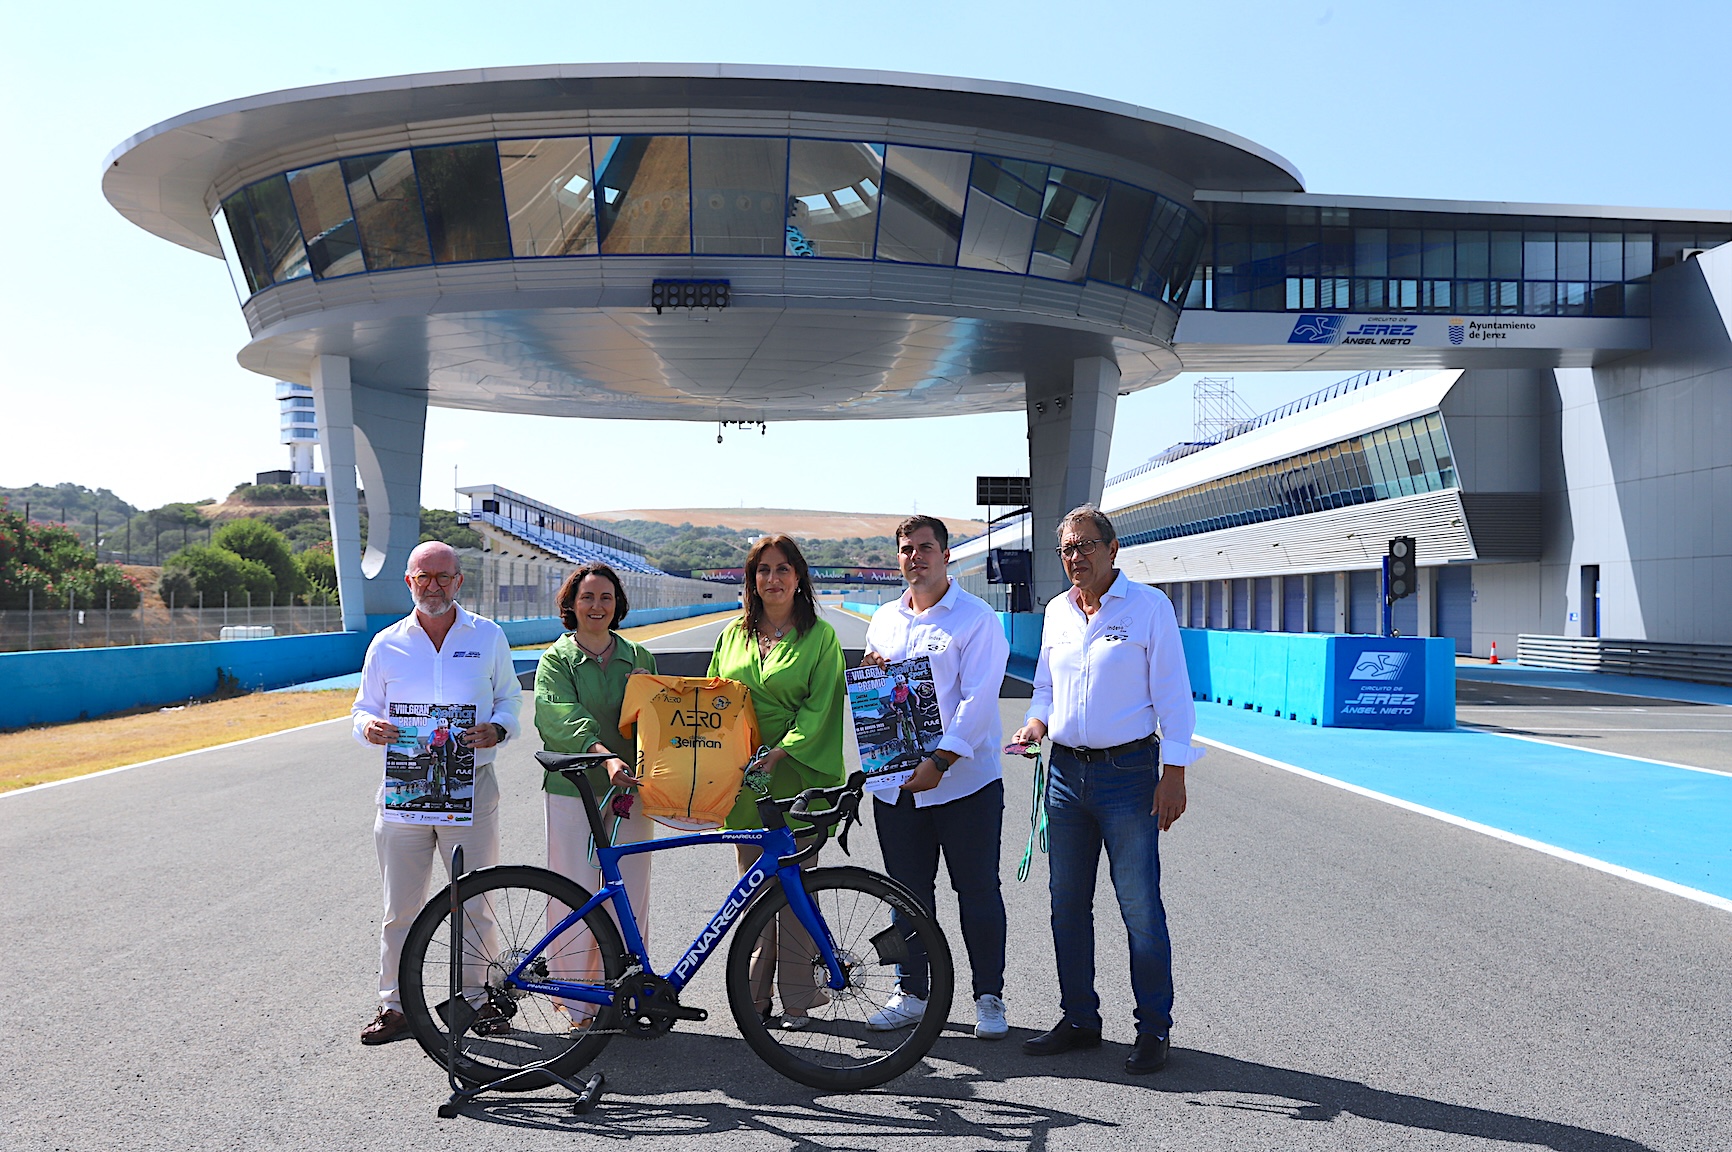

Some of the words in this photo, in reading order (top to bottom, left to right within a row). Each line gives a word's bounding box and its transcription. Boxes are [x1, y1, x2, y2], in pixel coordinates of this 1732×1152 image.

[1346, 324, 1418, 336] JEREZ
[1469, 321, 1536, 331] Ayuntamiento
[1341, 336, 1377, 345] ÁNGEL
[1468, 331, 1481, 339] de
[1482, 330, 1507, 341] Jerez
[1344, 693, 1419, 705] JEREZ
[1340, 705, 1377, 714] ÁNGEL
[1379, 707, 1413, 715] NIETO
[398, 717, 428, 727] PREMIO
[670, 709, 722, 729] AERO
[674, 868, 765, 980] PINARELLO
